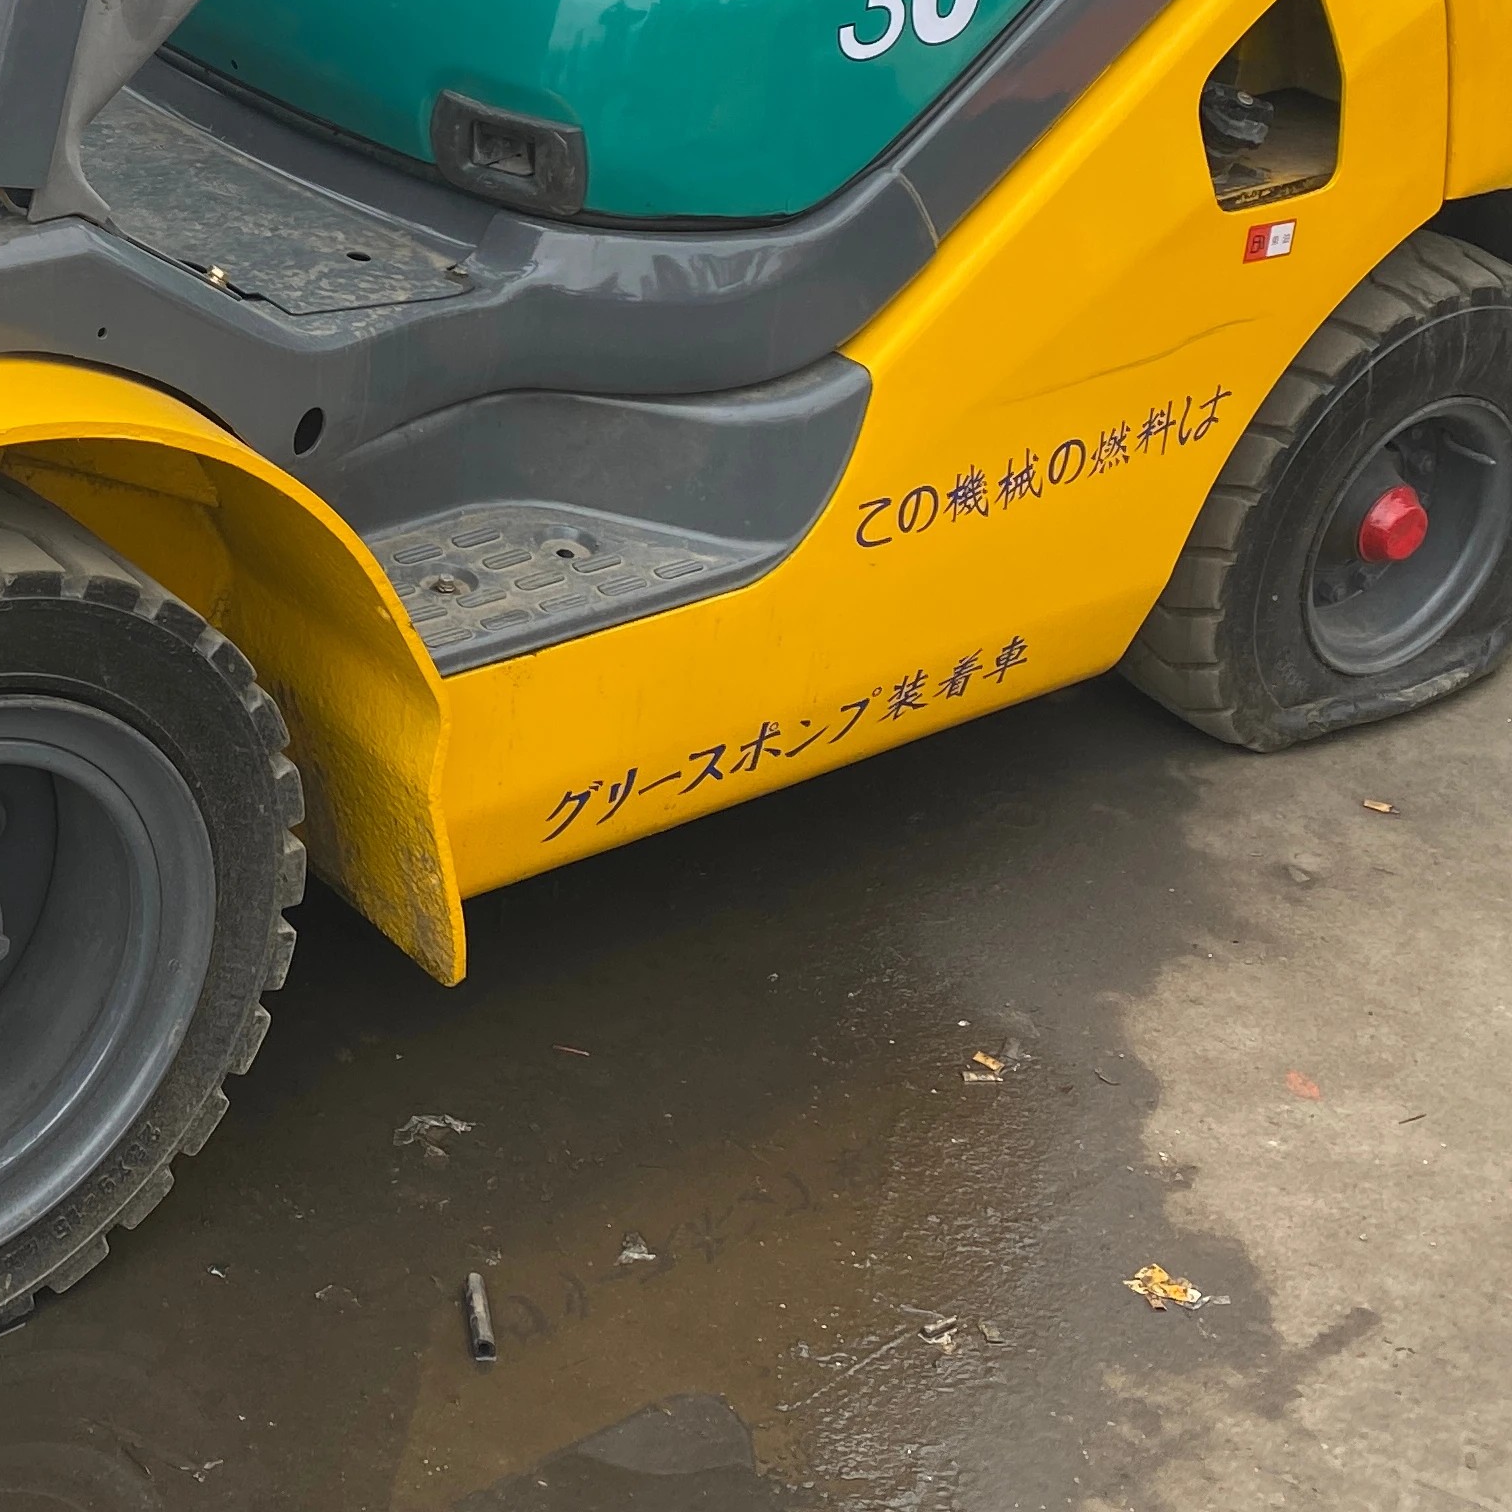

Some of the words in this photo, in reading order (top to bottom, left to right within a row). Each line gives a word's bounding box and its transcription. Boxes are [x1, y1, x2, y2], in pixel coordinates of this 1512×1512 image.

[855, 384, 1233, 549] この機械の燃料は
[540, 634, 1029, 843] グリースポンプ装着車
